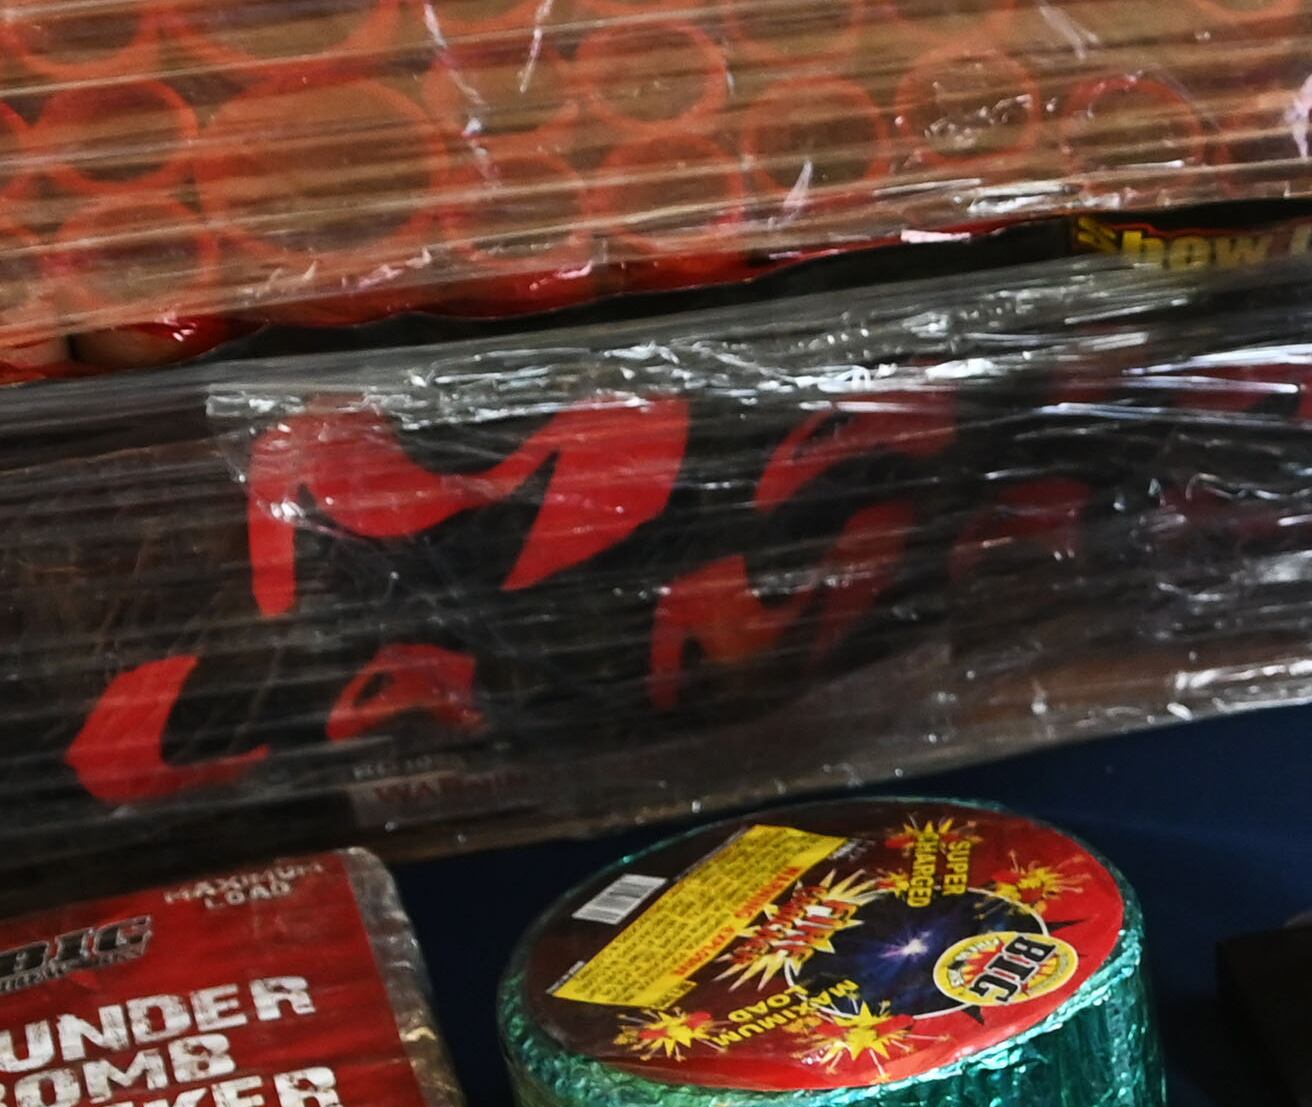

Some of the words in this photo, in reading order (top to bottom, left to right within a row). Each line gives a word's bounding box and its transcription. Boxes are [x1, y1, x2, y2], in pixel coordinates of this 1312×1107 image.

[164, 862, 324, 904] MAXIMUM
[942, 840, 973, 896] SUPER
[204, 880, 294, 910] LOAD
[970, 935, 1058, 1006] BIG
[714, 979, 859, 1047] MAXIMUM
[727, 984, 810, 1023] LOAD
